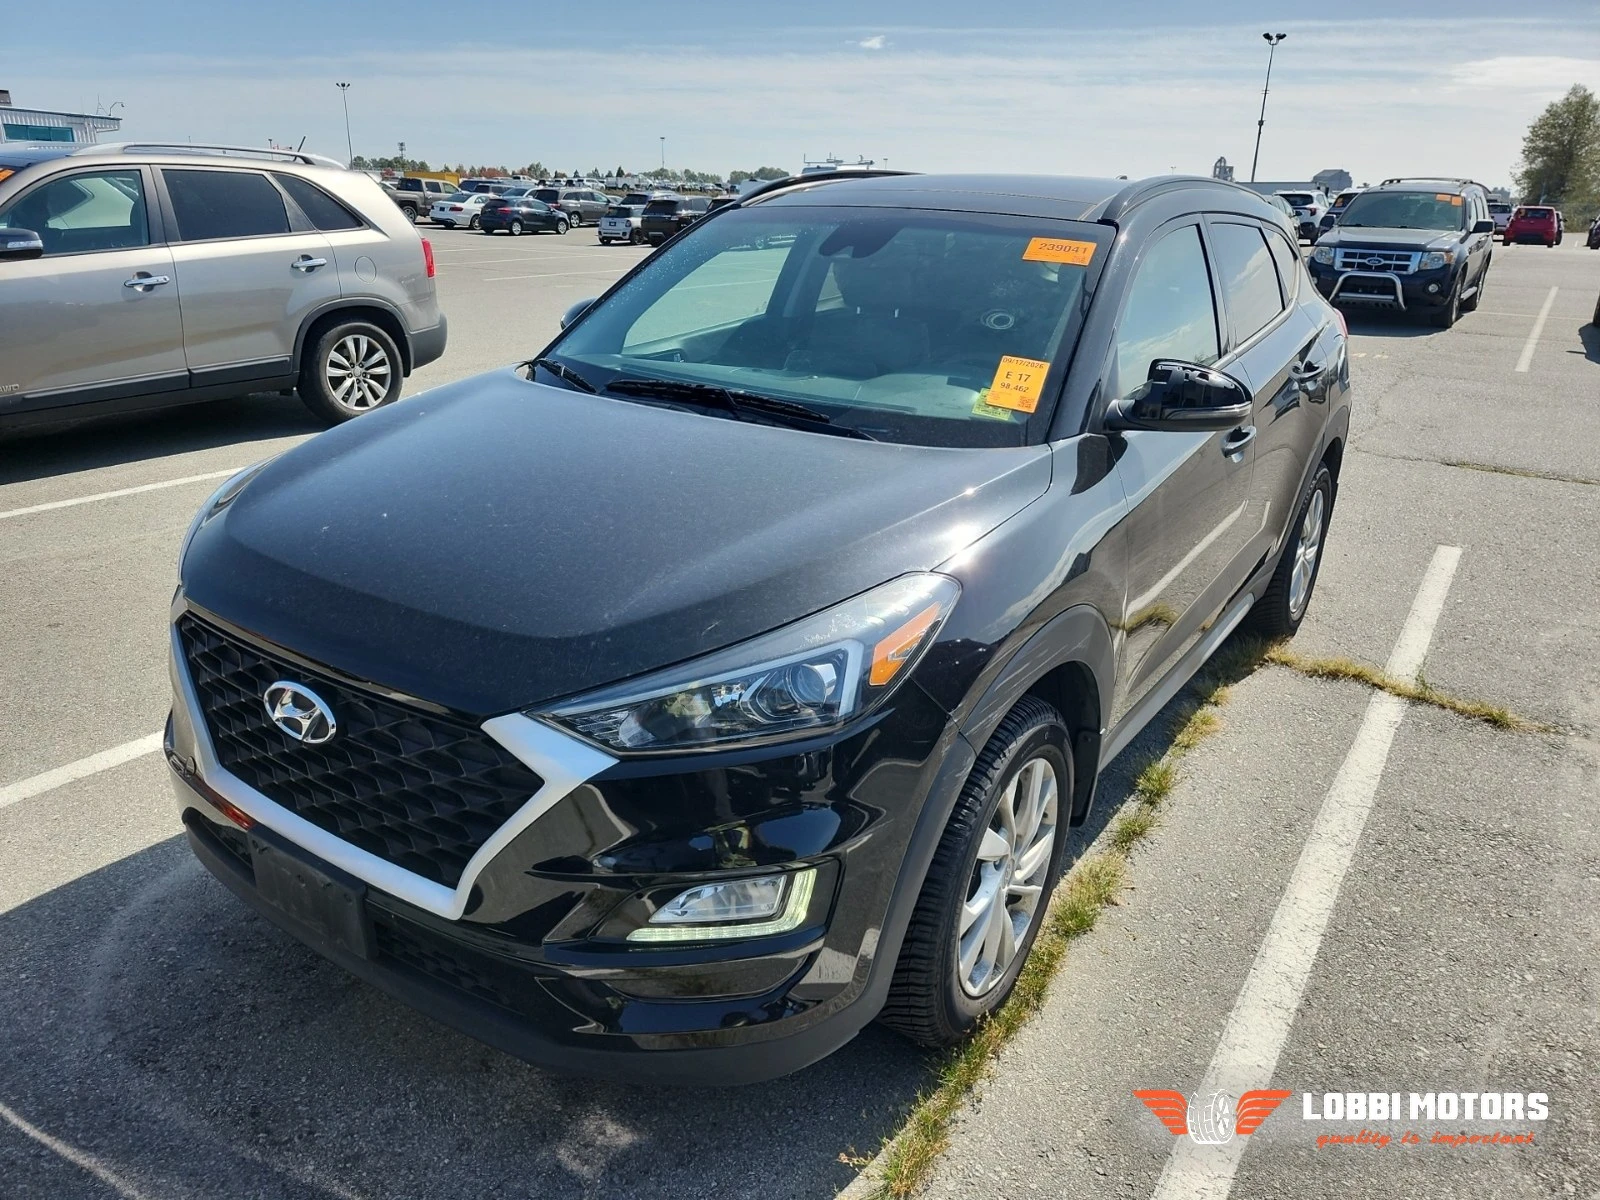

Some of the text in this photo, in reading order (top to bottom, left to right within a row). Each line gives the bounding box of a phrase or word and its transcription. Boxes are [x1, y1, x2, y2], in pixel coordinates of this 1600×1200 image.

[1038, 242, 1088, 254] 239041
[1005, 371, 1032, 383] E 17
